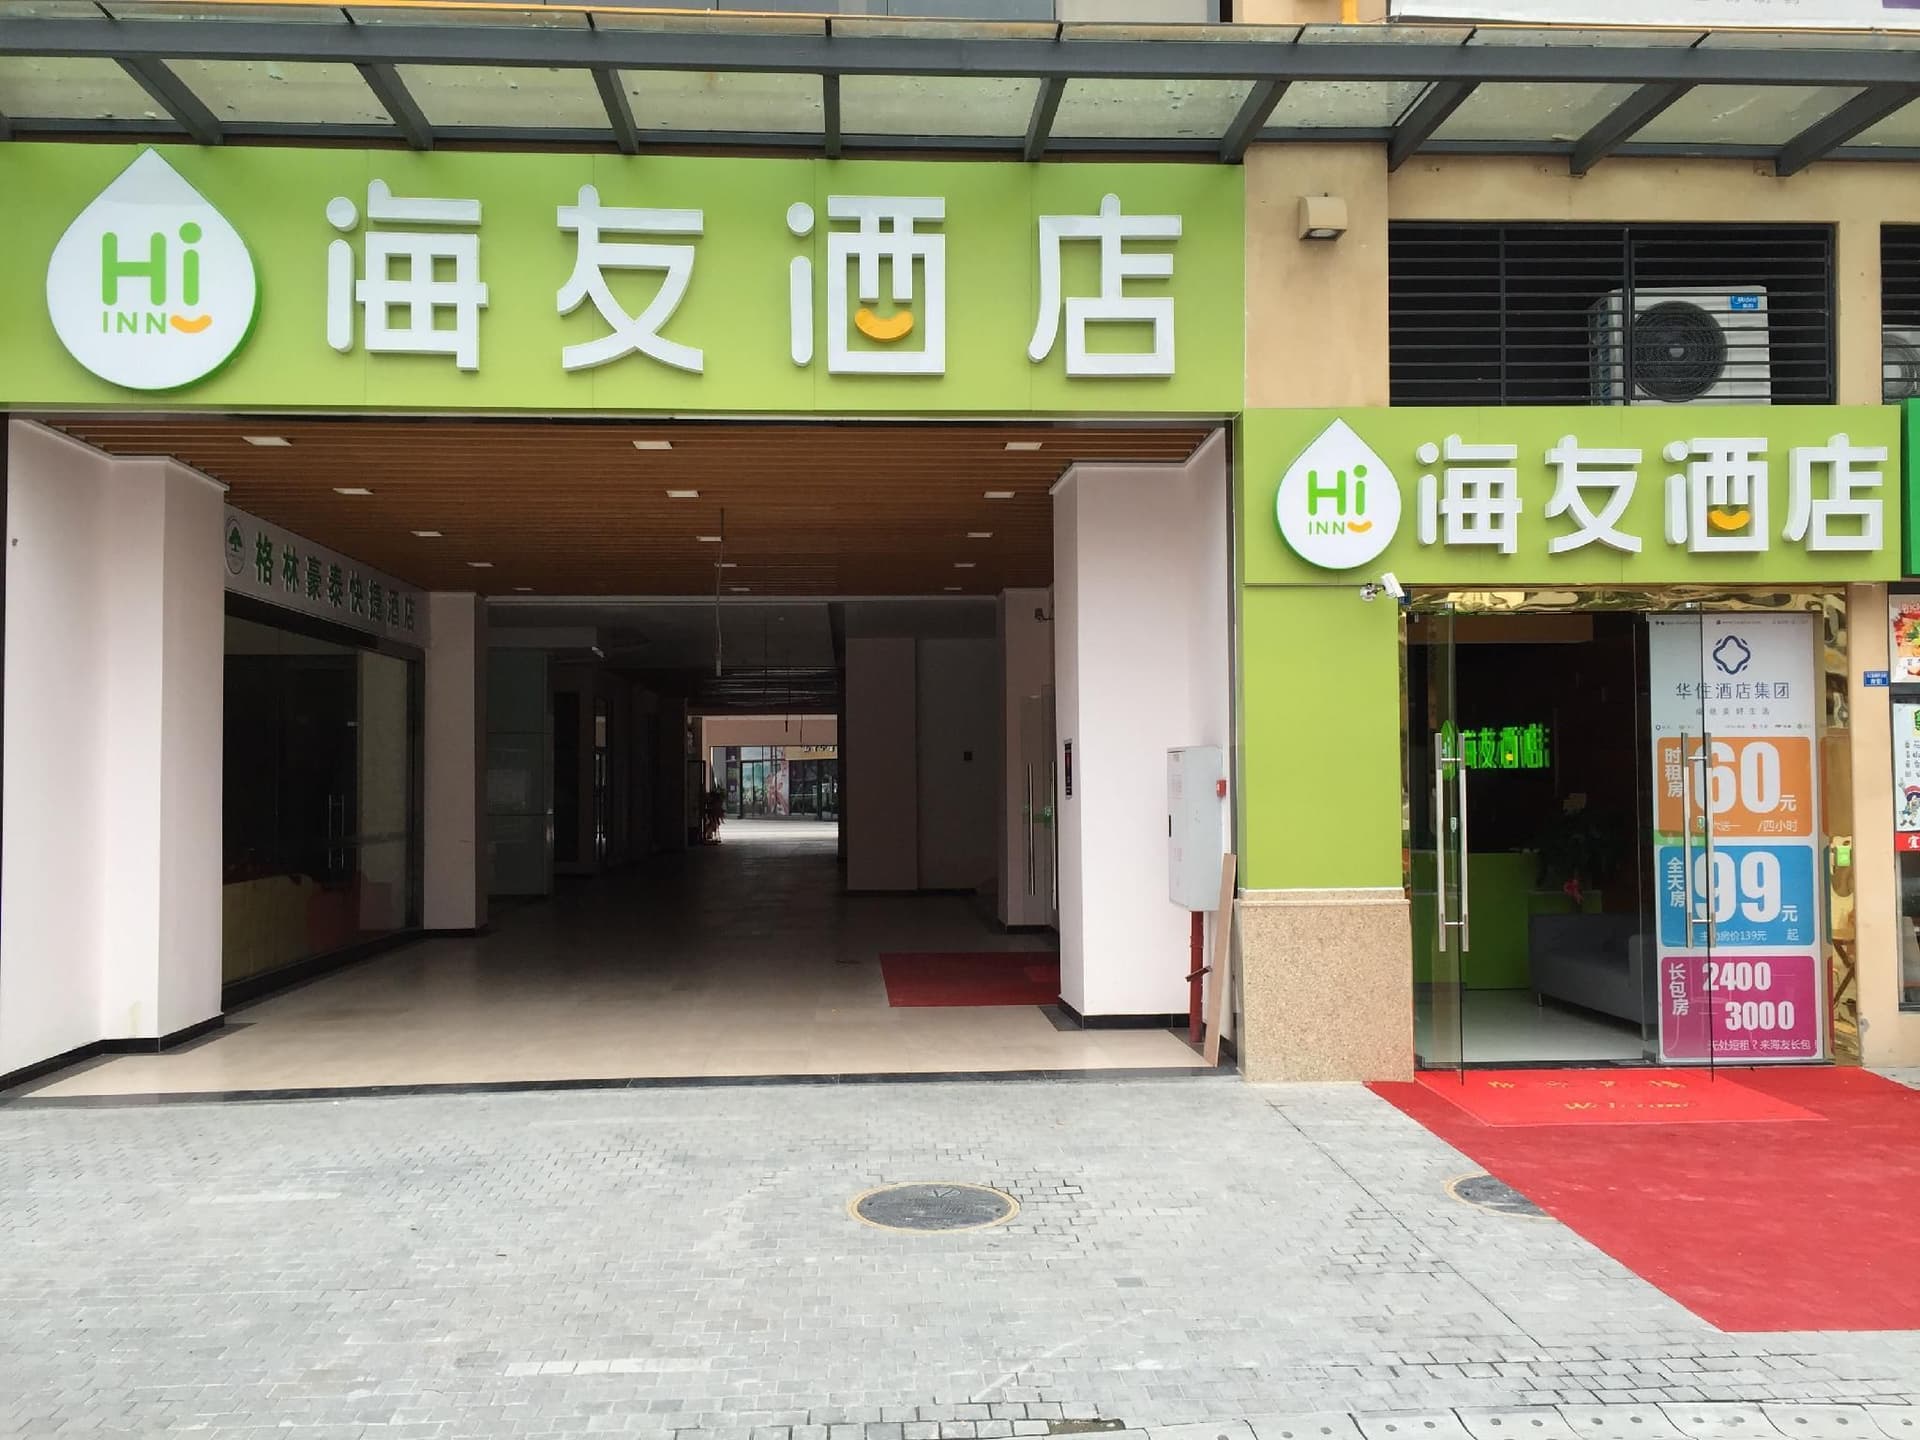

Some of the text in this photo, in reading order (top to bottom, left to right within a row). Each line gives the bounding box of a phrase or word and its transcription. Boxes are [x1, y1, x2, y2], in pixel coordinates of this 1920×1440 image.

[101, 221, 204, 307] Hi
[325, 178, 1183, 379] 海友酒店
[102, 311, 168, 335] INN
[1307, 464, 1369, 517] Hi
[1415, 432, 1889, 555] 海友酒店
[1308, 520, 1346, 536] INN
[254, 531, 416, 633] 格林豪泰快捷酒店
[1675, 682, 1791, 701] 华住酒店集团
[1664, 747, 1683, 798] 时租房
[1693, 741, 1781, 814] 60
[1779, 794, 1797, 812] 元
[1667, 856, 1686, 908] 全天房
[1693, 851, 1782, 924] 99
[1781, 905, 1798, 923] 元
[1785, 927, 1800, 942] 起
[1668, 961, 1690, 1016] 长包房
[1702, 962, 1772, 992] 2400
[1725, 1000, 1796, 1032] 3000
